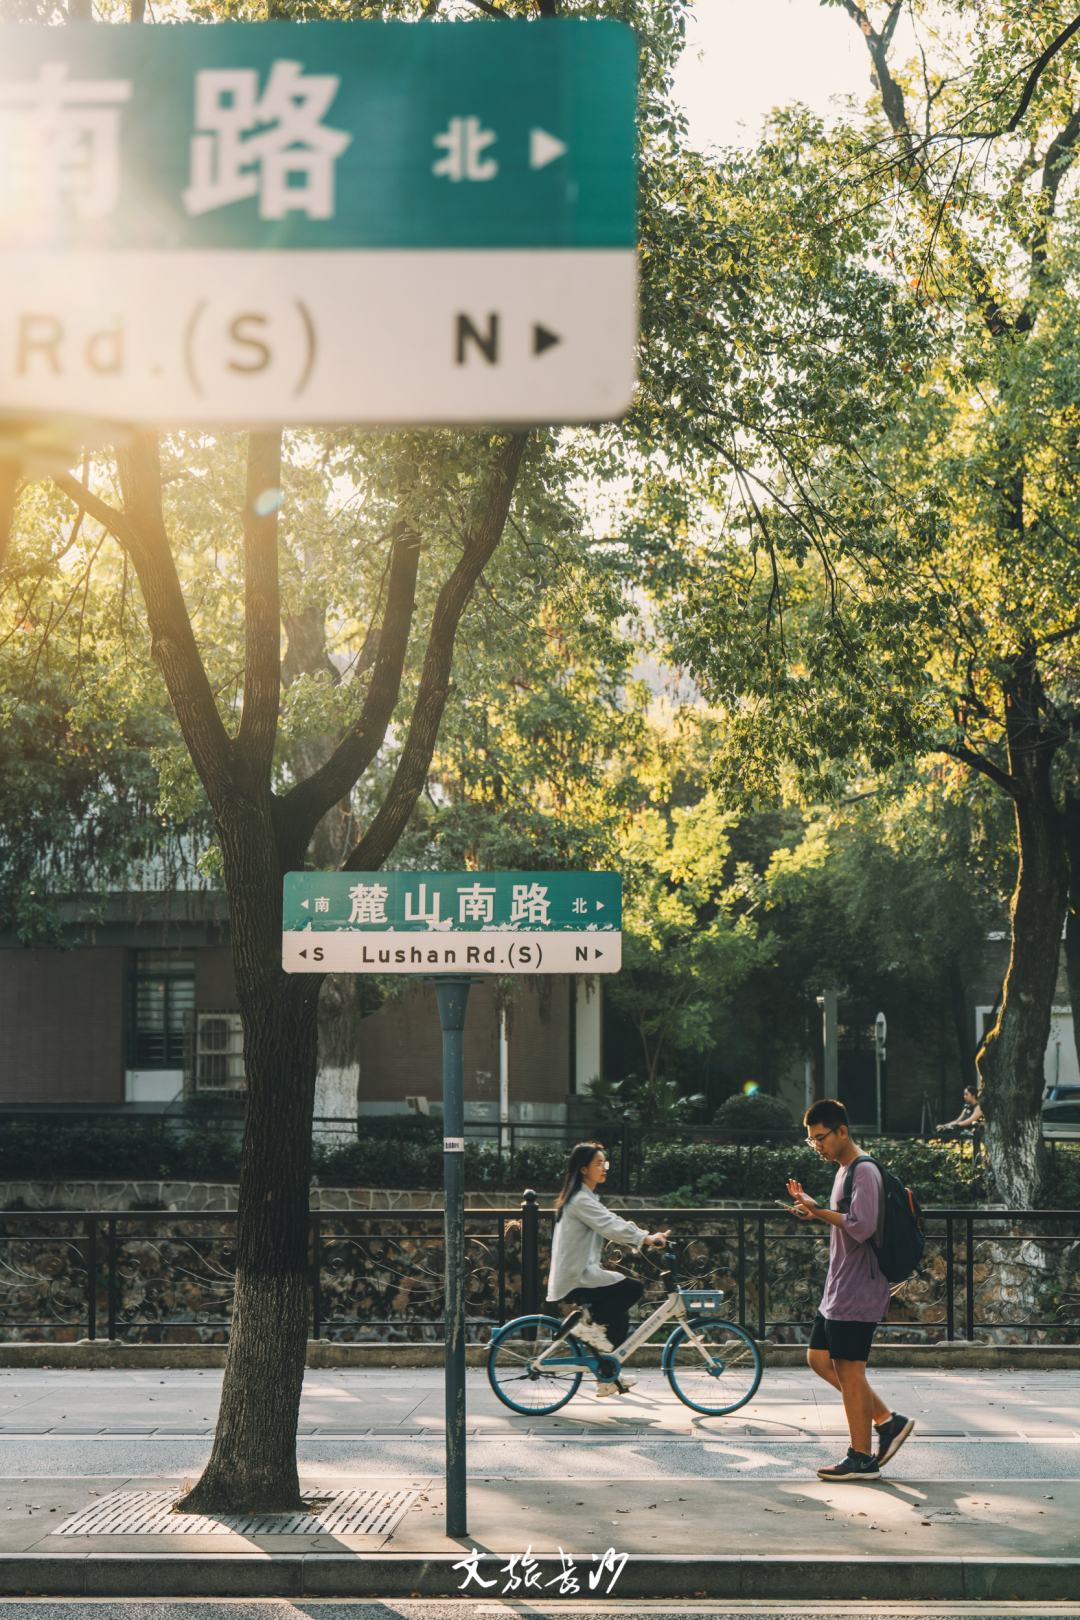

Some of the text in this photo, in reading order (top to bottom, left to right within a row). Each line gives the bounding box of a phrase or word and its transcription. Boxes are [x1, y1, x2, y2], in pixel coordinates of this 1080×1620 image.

[432, 116, 498, 182] 北
[455, 311, 501, 367] N
[315, 896, 330, 913] 南
[348, 883, 551, 923] 麓山南路
[572, 898, 588, 914] 北
[313, 947, 324, 961] S
[362, 946, 456, 963] Lushan
[575, 946, 588, 961] N
